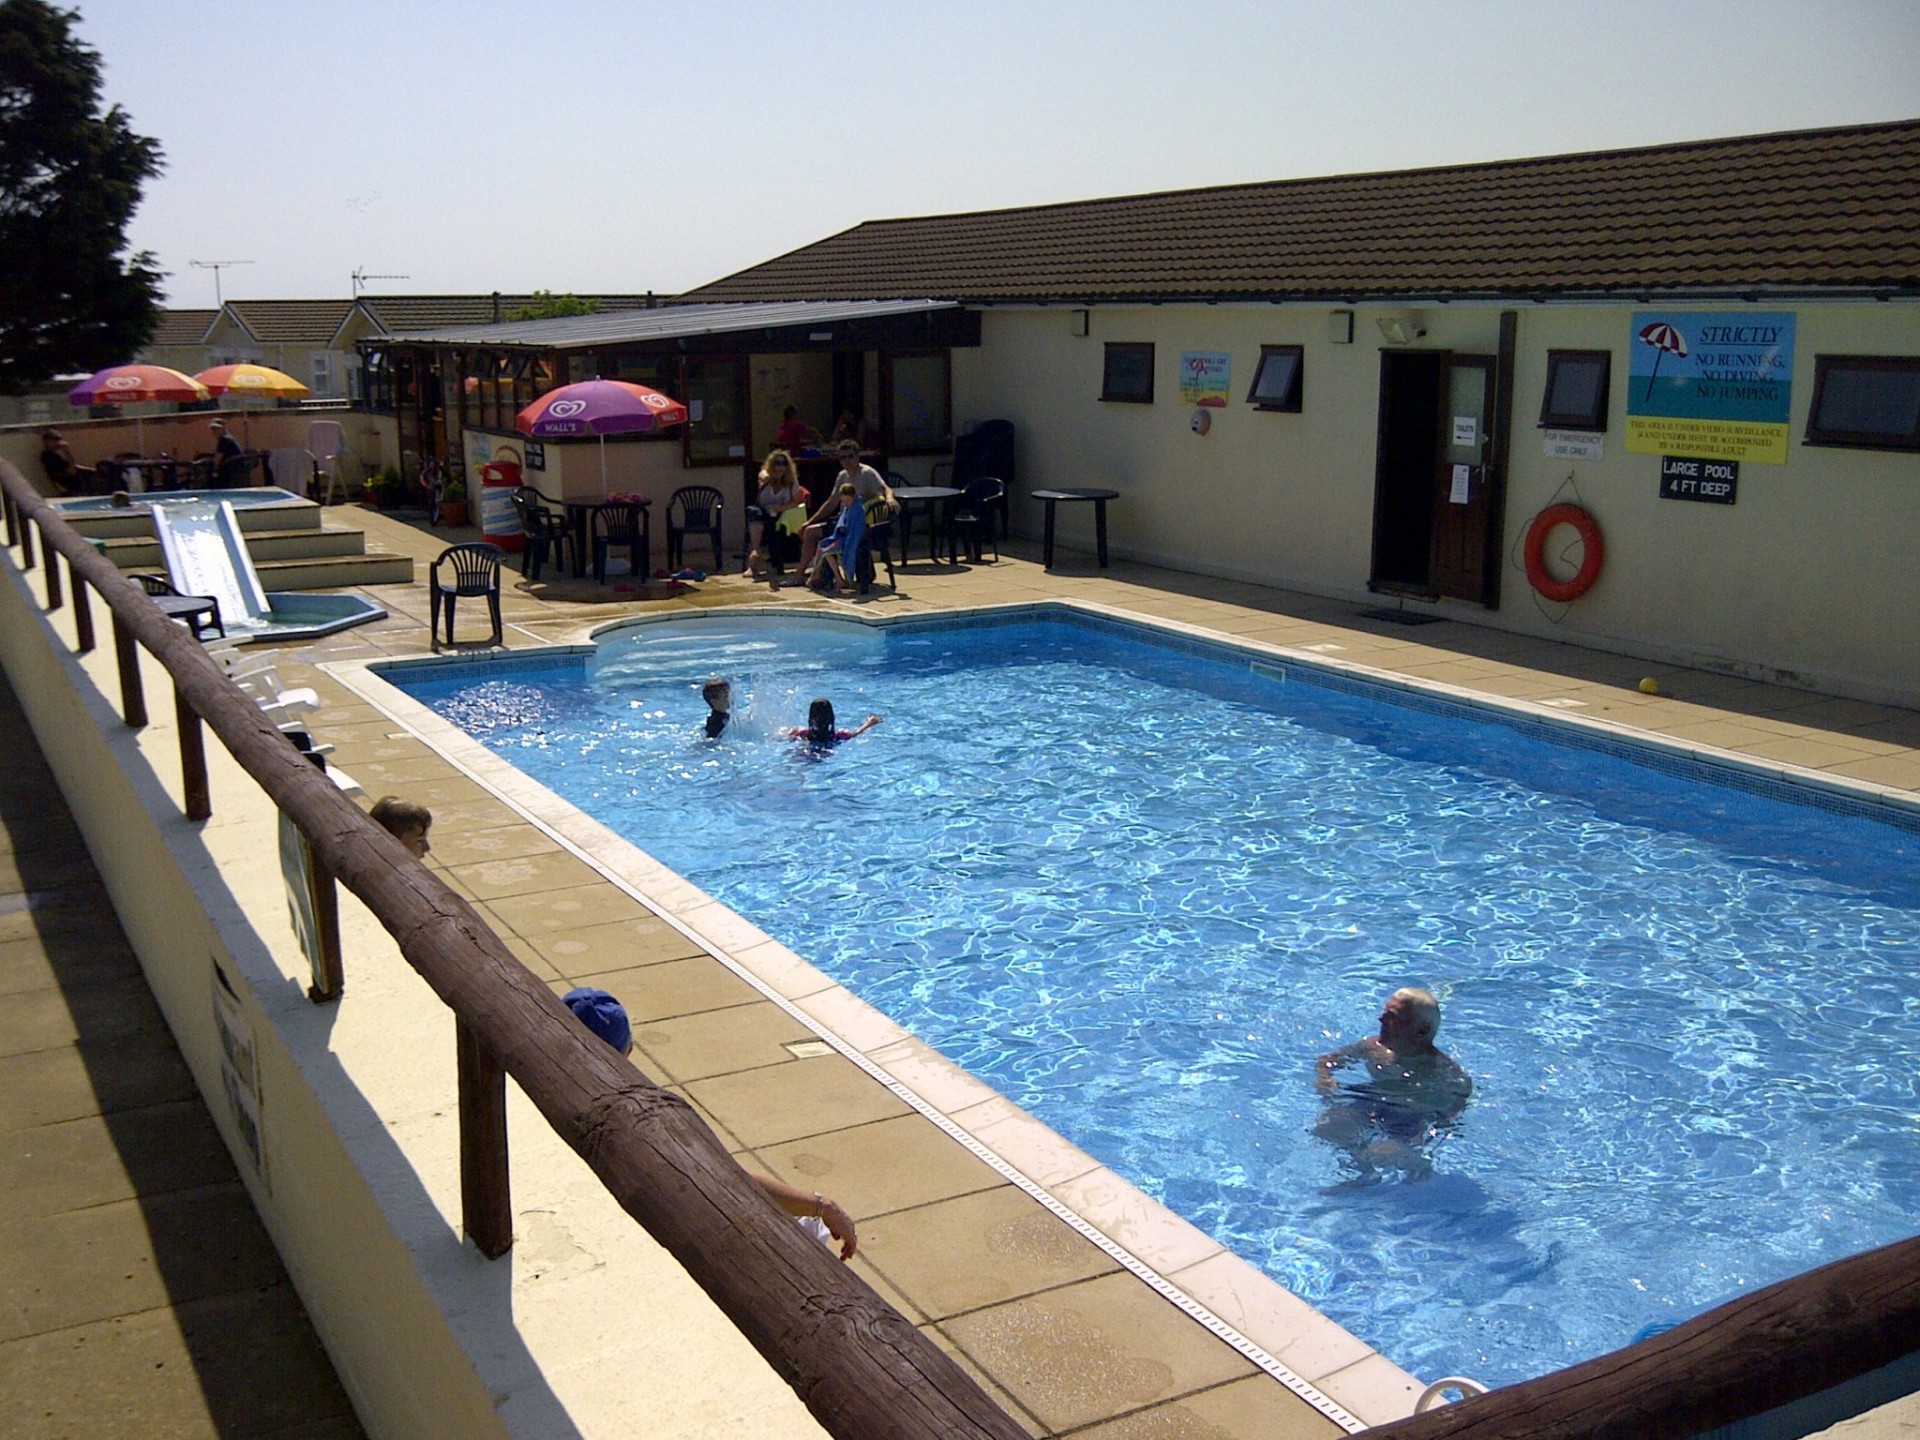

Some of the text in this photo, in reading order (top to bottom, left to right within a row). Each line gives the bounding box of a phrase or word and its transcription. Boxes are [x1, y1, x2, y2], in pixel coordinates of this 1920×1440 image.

[1700, 326, 1783, 343] STRICTLY
[1695, 353, 1714, 366] NO
[1702, 370, 1720, 381] NO
[1697, 385, 1779, 401] NO JUMPING
[544, 423, 576, 432] WALL'S
[1631, 420, 1646, 429] THIS
[1648, 421, 1665, 430] AREA
[1675, 423, 1700, 432] UNDER
[1702, 425, 1725, 433] VIDEO
[1727, 426, 1781, 437] SURVEILLANCE
[1645, 432, 1661, 440] AND
[1662, 432, 1686, 441] UNDER
[1688, 434, 1707, 442] MUST
[1710, 435, 1718, 443] BE
[1721, 436, 1772, 447] ACCOMPANIED
[1555, 445, 1568, 454] USE
[1663, 460, 1734, 479] LARGE POOL
[1670, 480, 1730, 496] 4 FT DEEP
